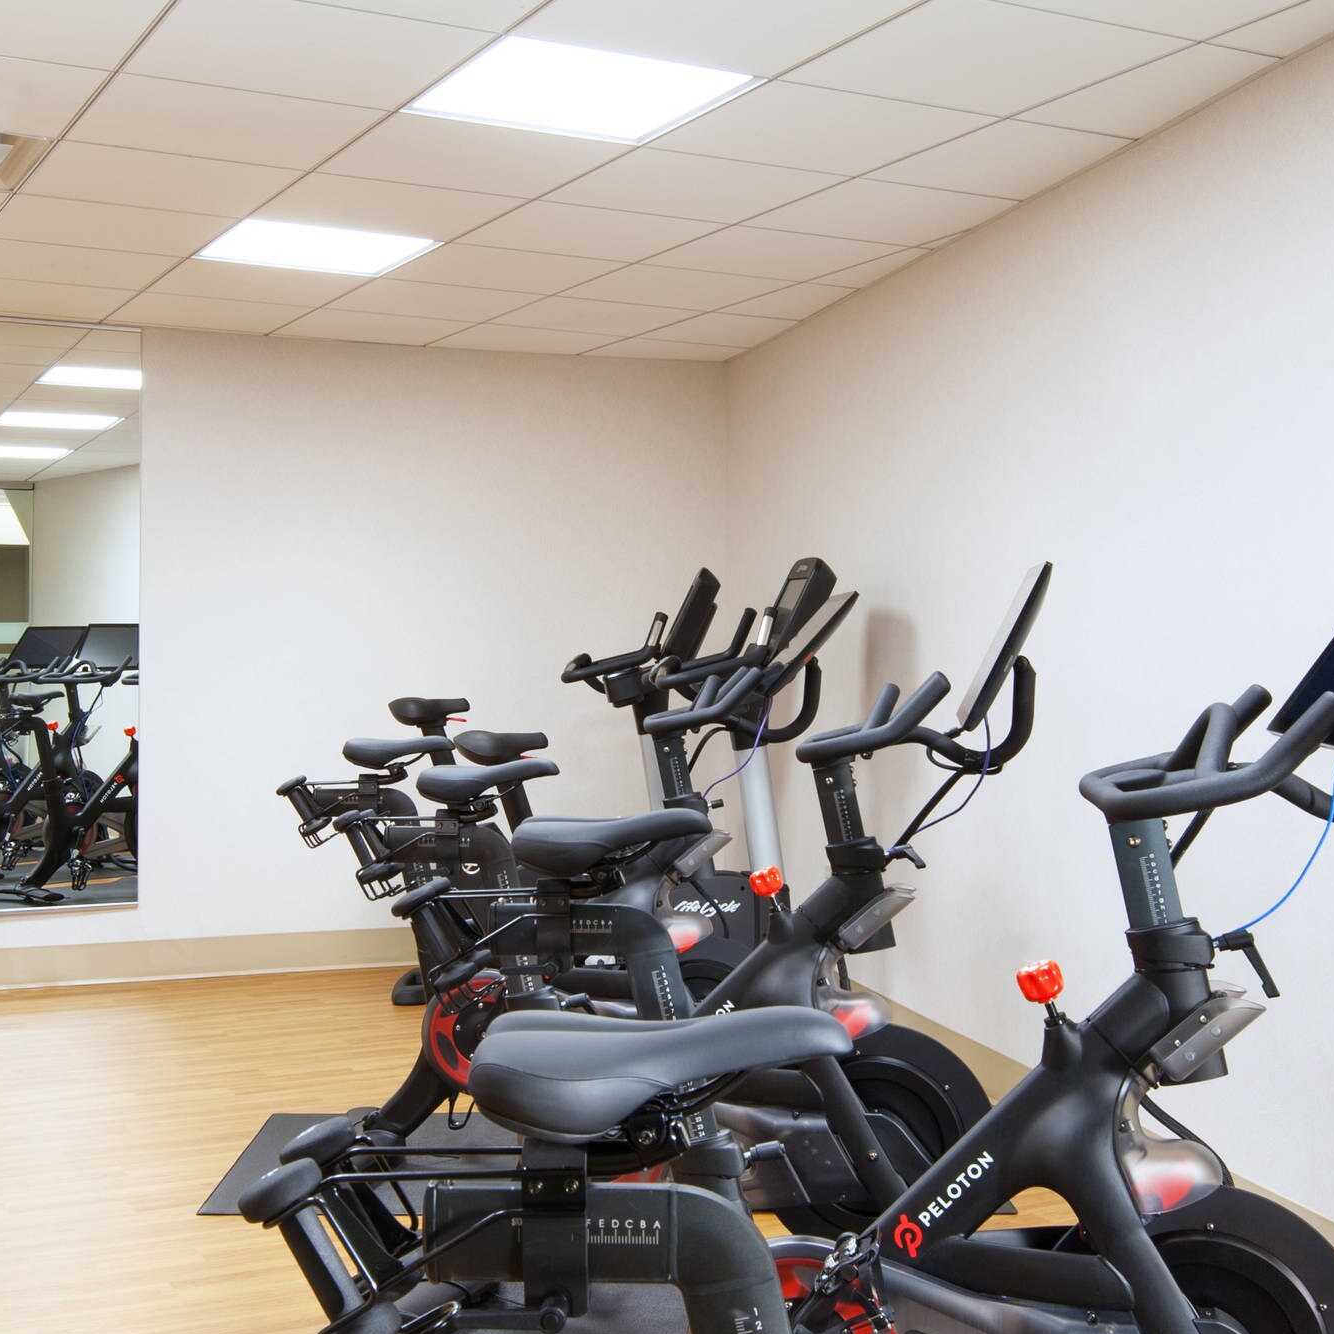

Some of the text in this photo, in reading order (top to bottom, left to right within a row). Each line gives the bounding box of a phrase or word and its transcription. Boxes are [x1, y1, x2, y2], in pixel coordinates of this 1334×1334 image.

[918, 1150, 994, 1228] PELOTON
[598, 1219, 605, 1228] E
[611, 1219, 620, 1228] D
[624, 1219, 633, 1229] C
[640, 1219, 647, 1229] B
[653, 1220, 662, 1229] A
[753, 1307, 759, 1317] 1
[755, 1321, 763, 1331] 2
